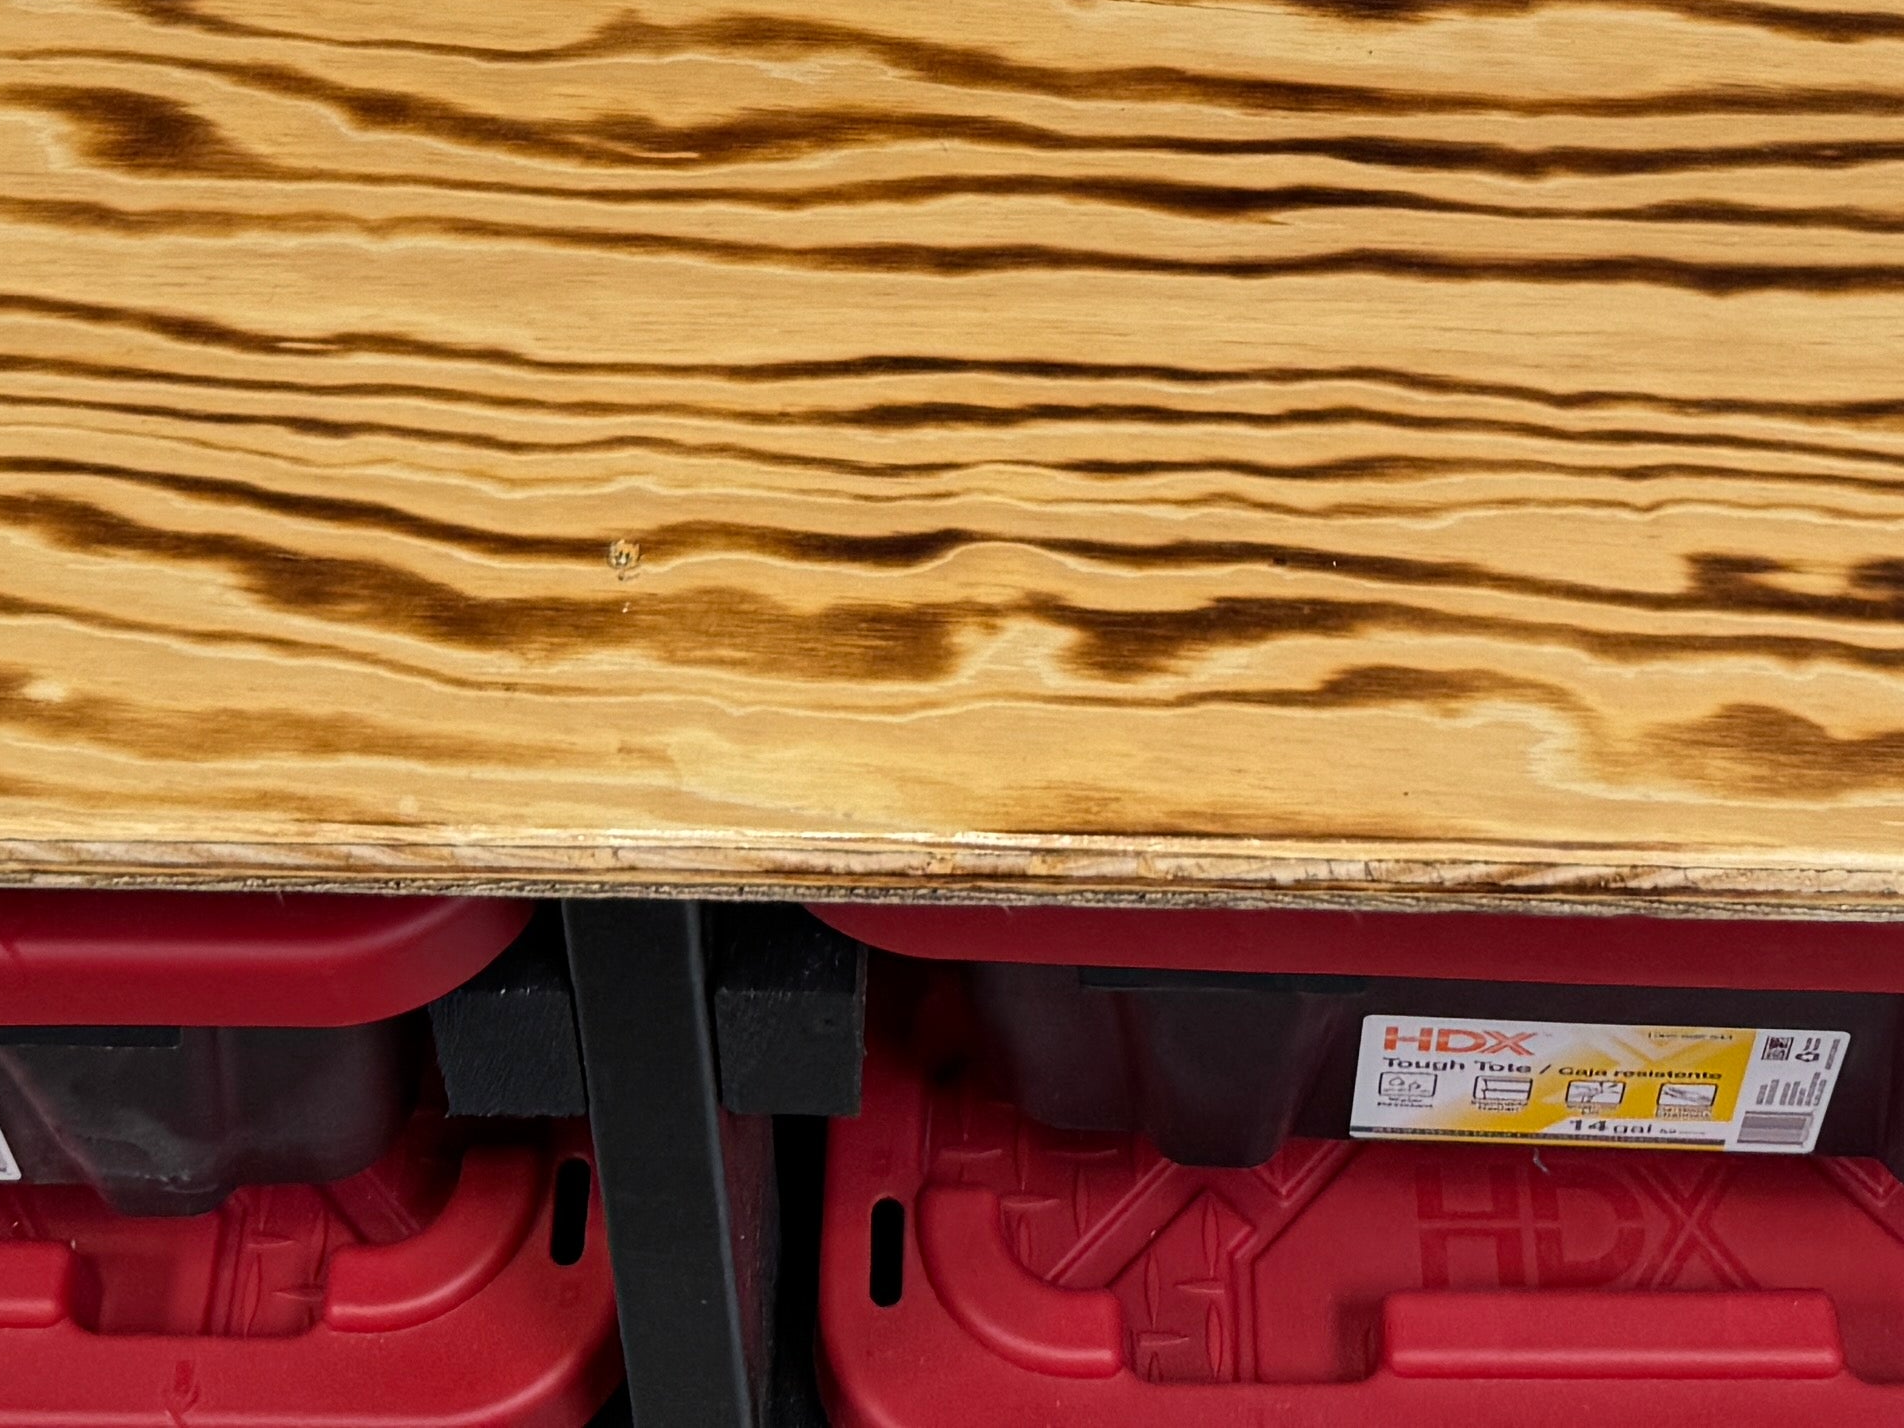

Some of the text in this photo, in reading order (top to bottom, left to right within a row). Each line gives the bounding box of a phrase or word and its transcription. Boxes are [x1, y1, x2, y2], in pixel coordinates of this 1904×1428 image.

[1383, 1025, 1538, 1057] HDX
[1382, 1056, 1466, 1072] Tough
[1473, 1059, 1533, 1074] Tote
[1569, 1119, 1608, 1132] 14
[1413, 1160, 1764, 1291] HDX
